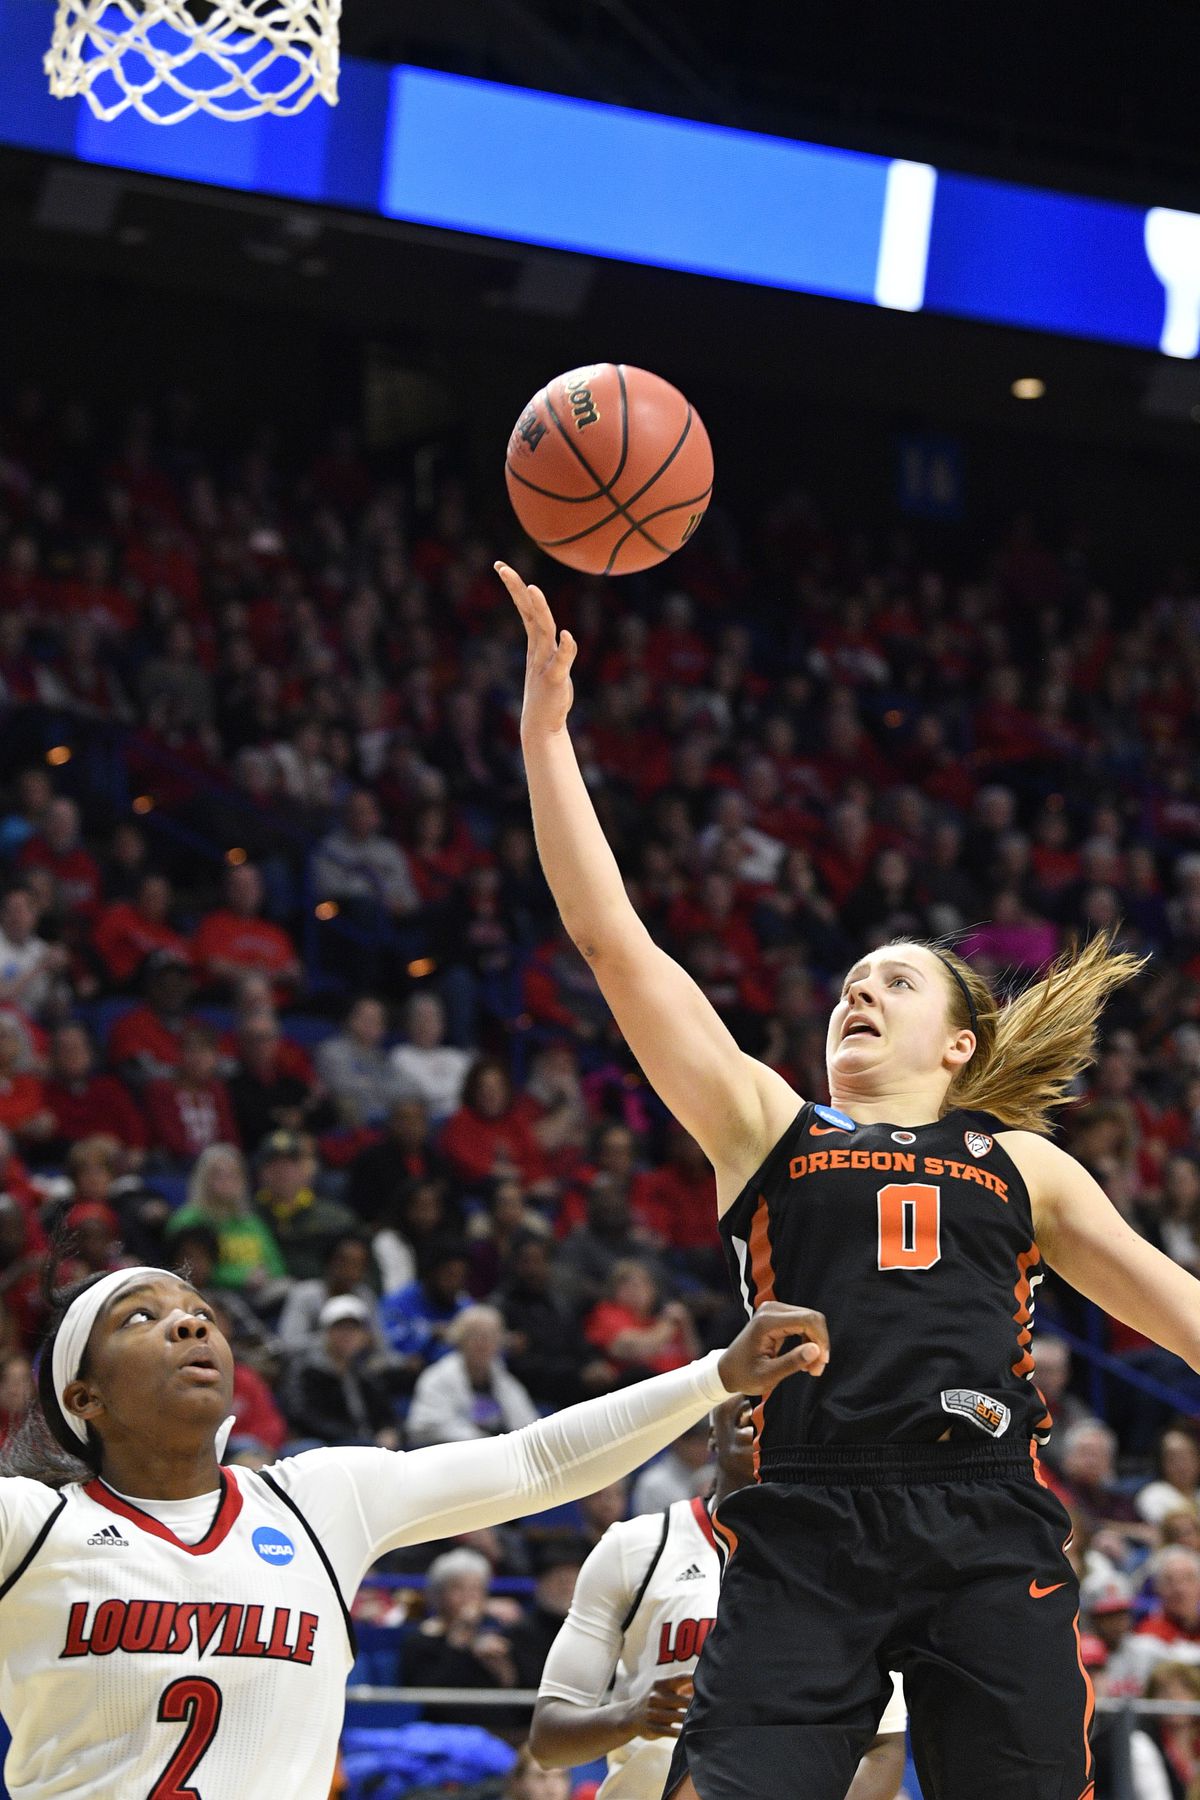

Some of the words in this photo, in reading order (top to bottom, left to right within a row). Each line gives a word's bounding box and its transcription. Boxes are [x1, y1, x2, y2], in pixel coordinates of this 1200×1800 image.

[789, 1150, 916, 1180] OREGON
[924, 1157, 1009, 1204] STATE
[877, 1183, 941, 1271] 0
[977, 1395, 1005, 1416] NIKE
[87, 1535, 129, 1547] adidas
[258, 1544, 294, 1557] NCAA
[58, 1599, 319, 1666] LOUISVILLE
[147, 1675, 223, 1800] 2
